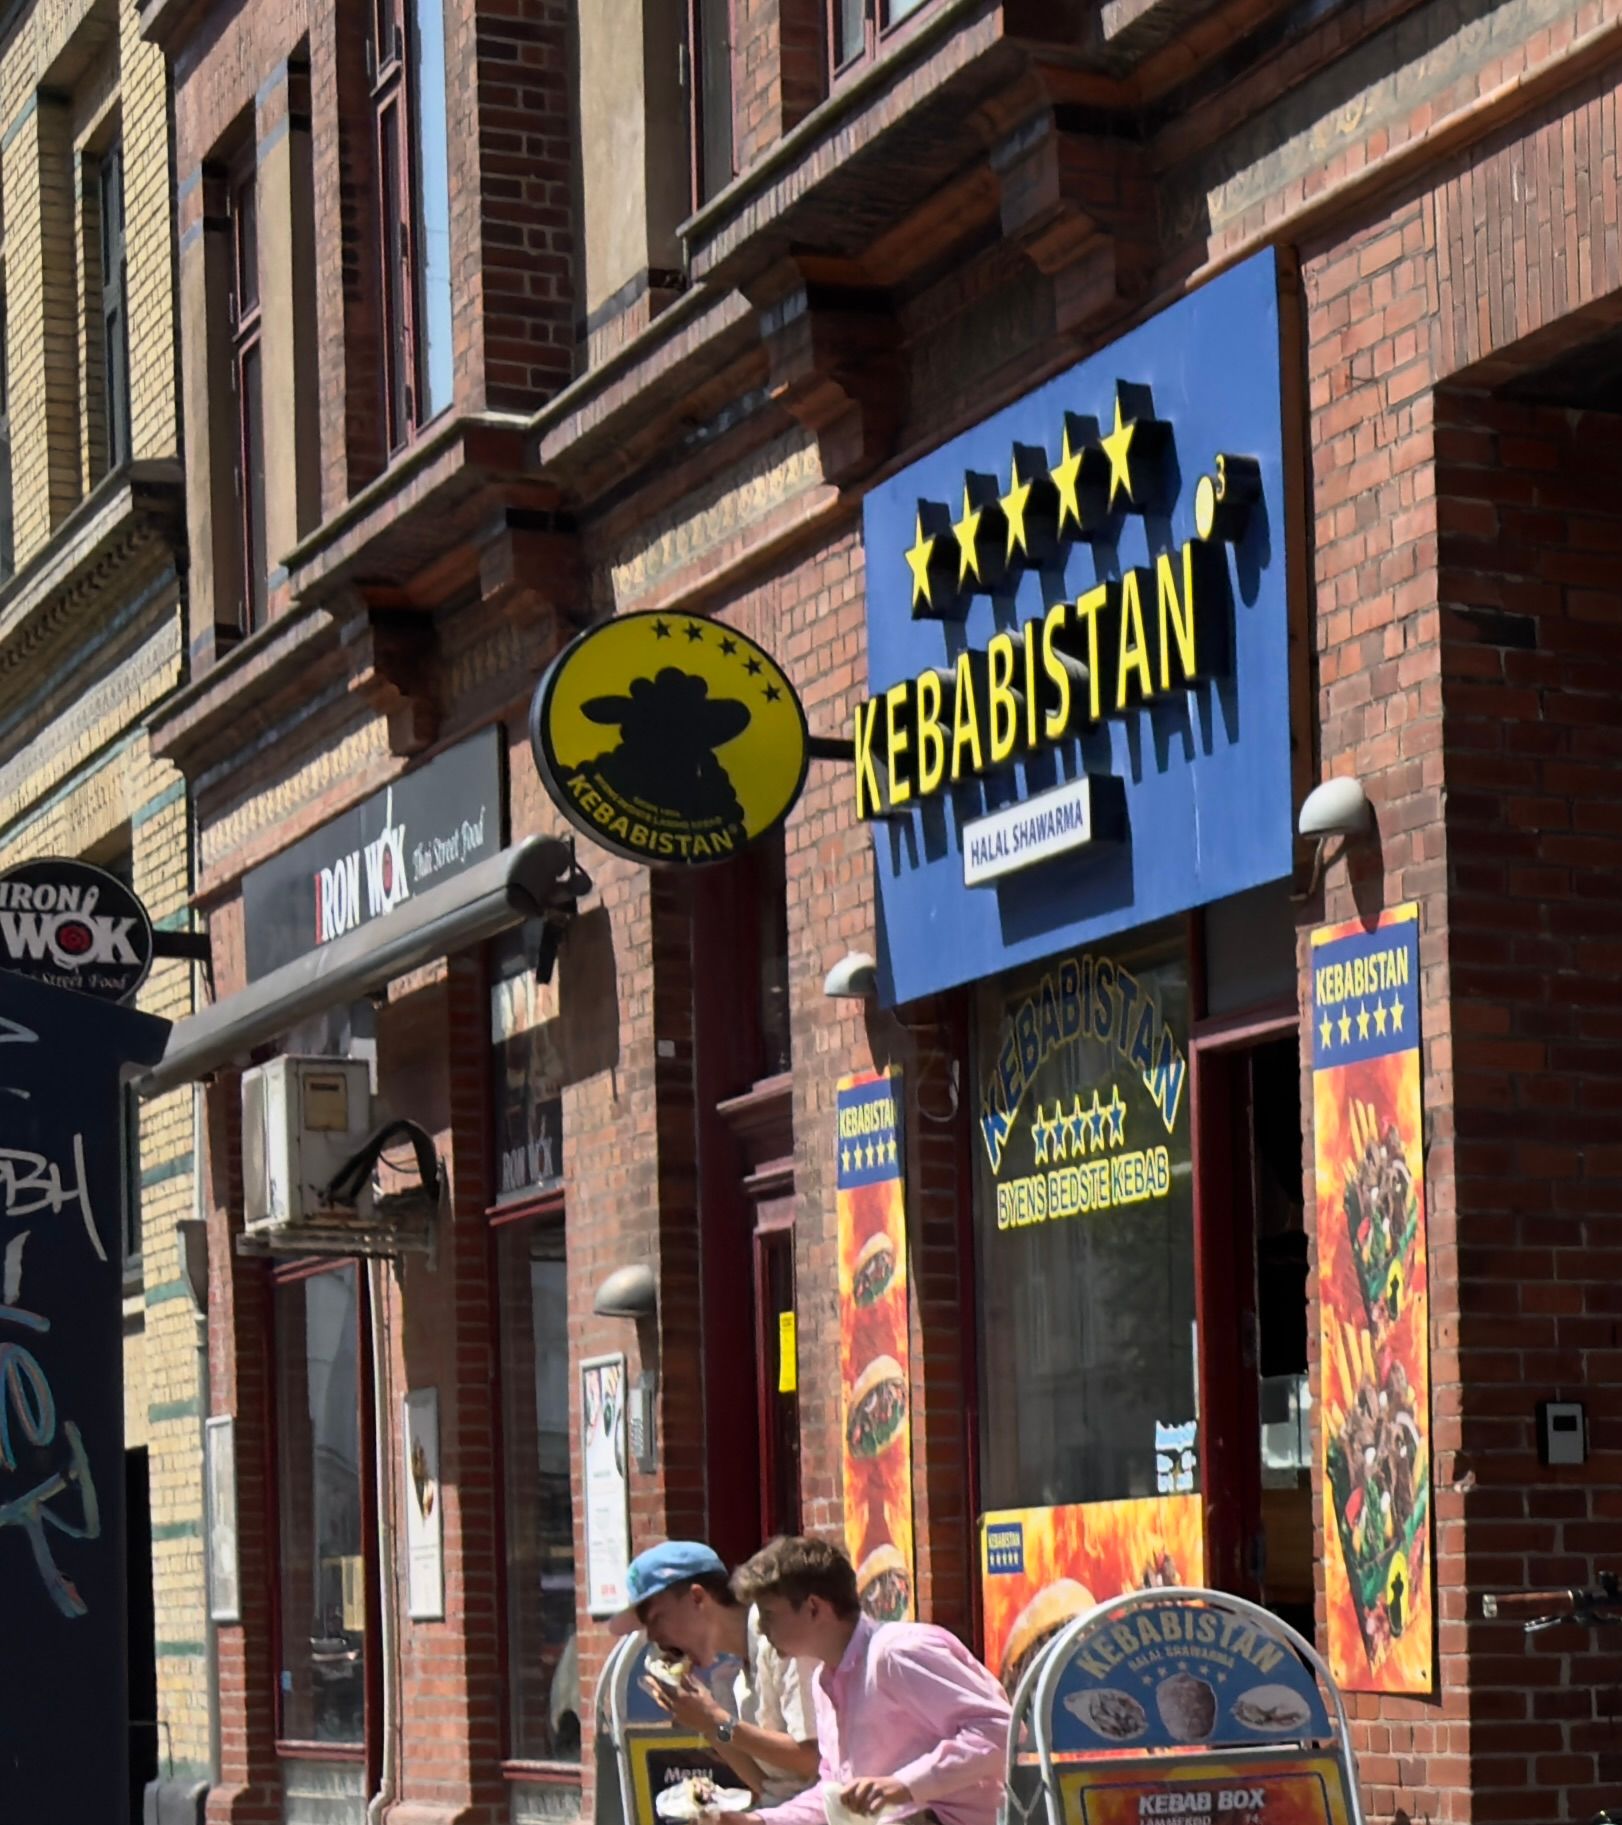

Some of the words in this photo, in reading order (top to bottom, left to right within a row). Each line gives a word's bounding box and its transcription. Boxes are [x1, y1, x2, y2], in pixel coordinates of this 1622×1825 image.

[854, 539, 1198, 820] KEBABISTAN
[567, 774, 735, 857] KEBABISTAN
[970, 829, 1010, 868] HALAL
[1012, 799, 1084, 853] SHAWARMA
[0, 881, 81, 911] IRON
[314, 850, 361, 945] IRON
[364, 822, 410, 917] WOK
[0, 905, 143, 969] WOK
[1316, 945, 1409, 1007] KEBABISTAN
[980, 954, 1186, 1175] KEBABISTAN
[998, 1174, 1047, 1229] BYENS
[1048, 1159, 1110, 1219] BEDSTE
[1111, 1146, 1169, 1205] KEBAB
[1077, 1611, 1285, 1680] KEBABISTAN
[663, 1767, 713, 1783] Menu
[1138, 1792, 1212, 1815] KEBAB
[1218, 1788, 1265, 1810] BOX
